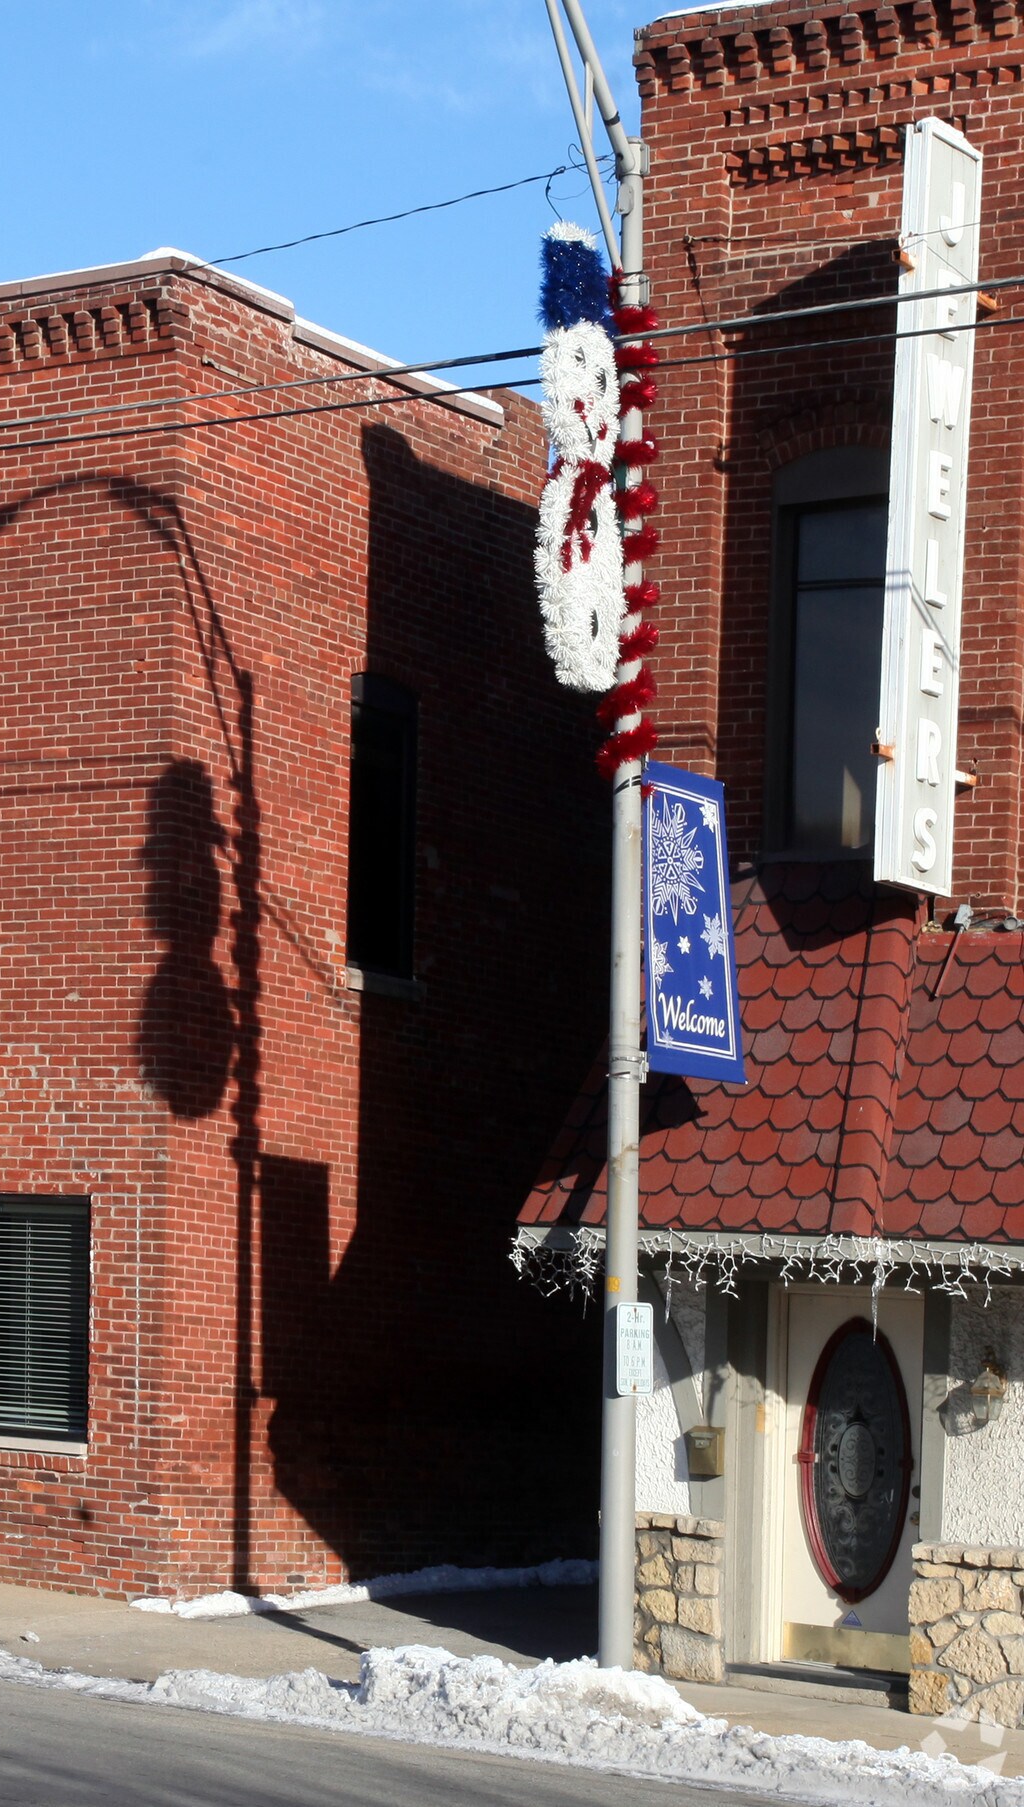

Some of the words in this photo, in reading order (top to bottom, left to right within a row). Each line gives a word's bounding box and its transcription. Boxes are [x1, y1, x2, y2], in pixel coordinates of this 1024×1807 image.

[911, 181, 965, 873] JEWELERS
[658, 992, 725, 1038] Welcome
[621, 1328, 650, 1339] PARKING
